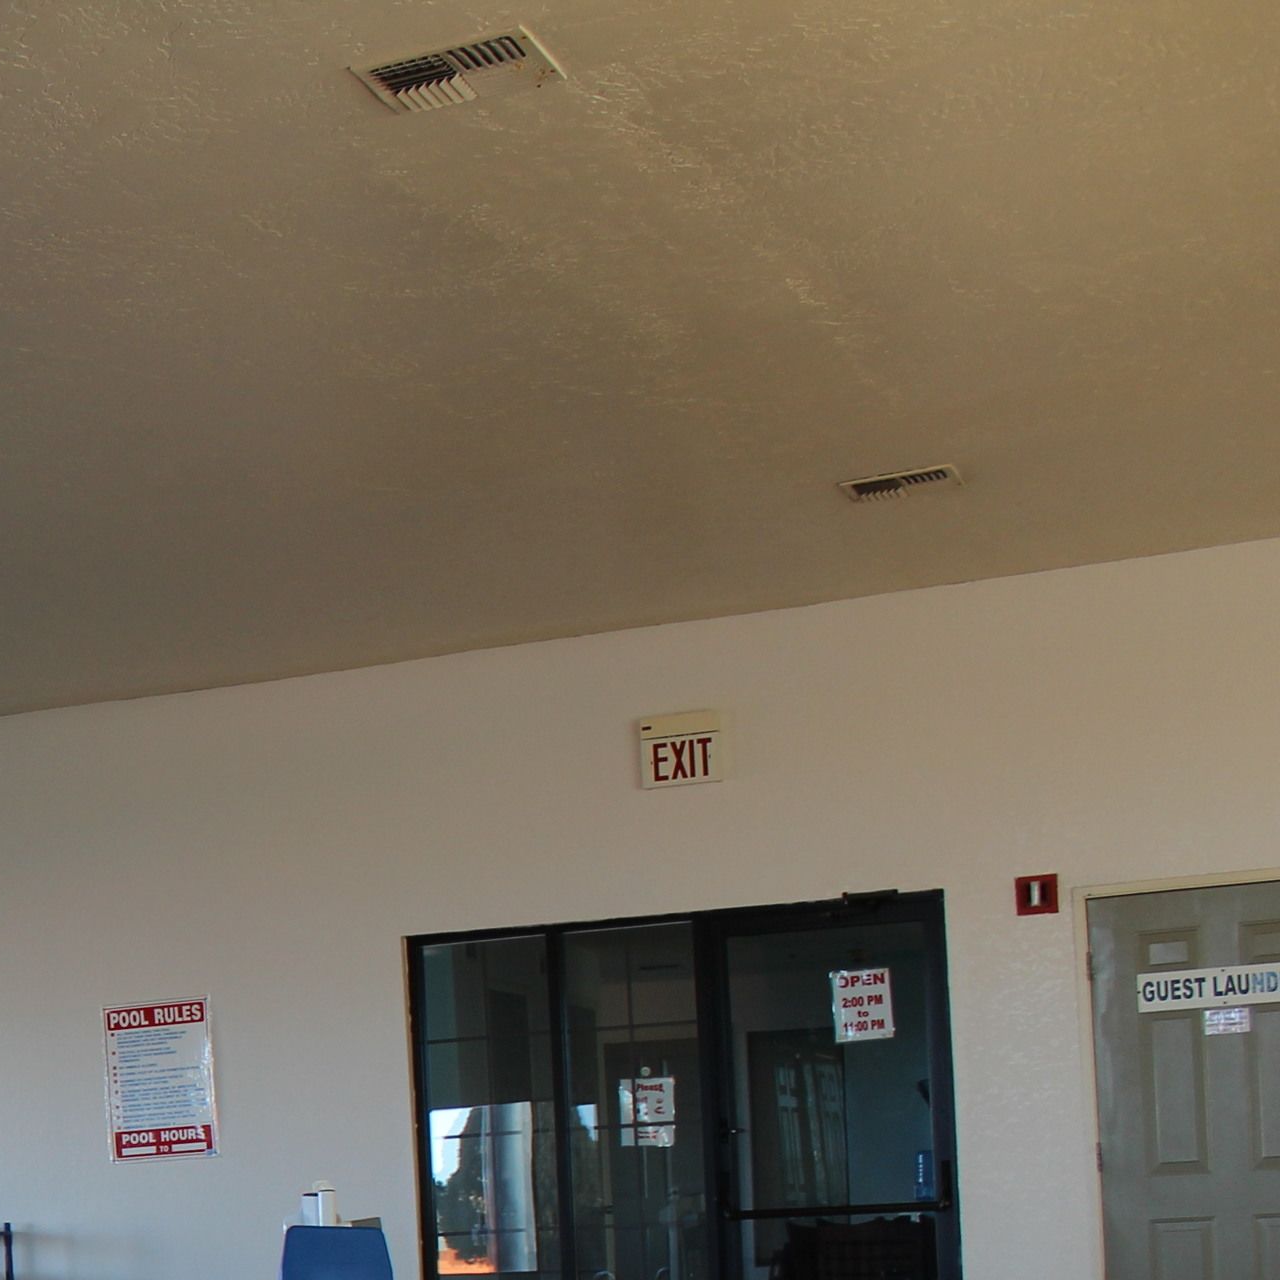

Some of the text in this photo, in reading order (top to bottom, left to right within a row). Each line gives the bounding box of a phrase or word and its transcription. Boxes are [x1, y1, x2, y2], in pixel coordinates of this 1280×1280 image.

[653, 737, 712, 782] EXIT
[837, 973, 885, 988] OPEN
[1142, 976, 1206, 1002] GUEST
[842, 994, 883, 1008] 2:00 PM
[109, 1004, 202, 1029] POOL RULES
[871, 1019, 885, 1030] PM
[121, 1127, 205, 1145] POOL HOURS
[159, 1145, 170, 1153] TO
